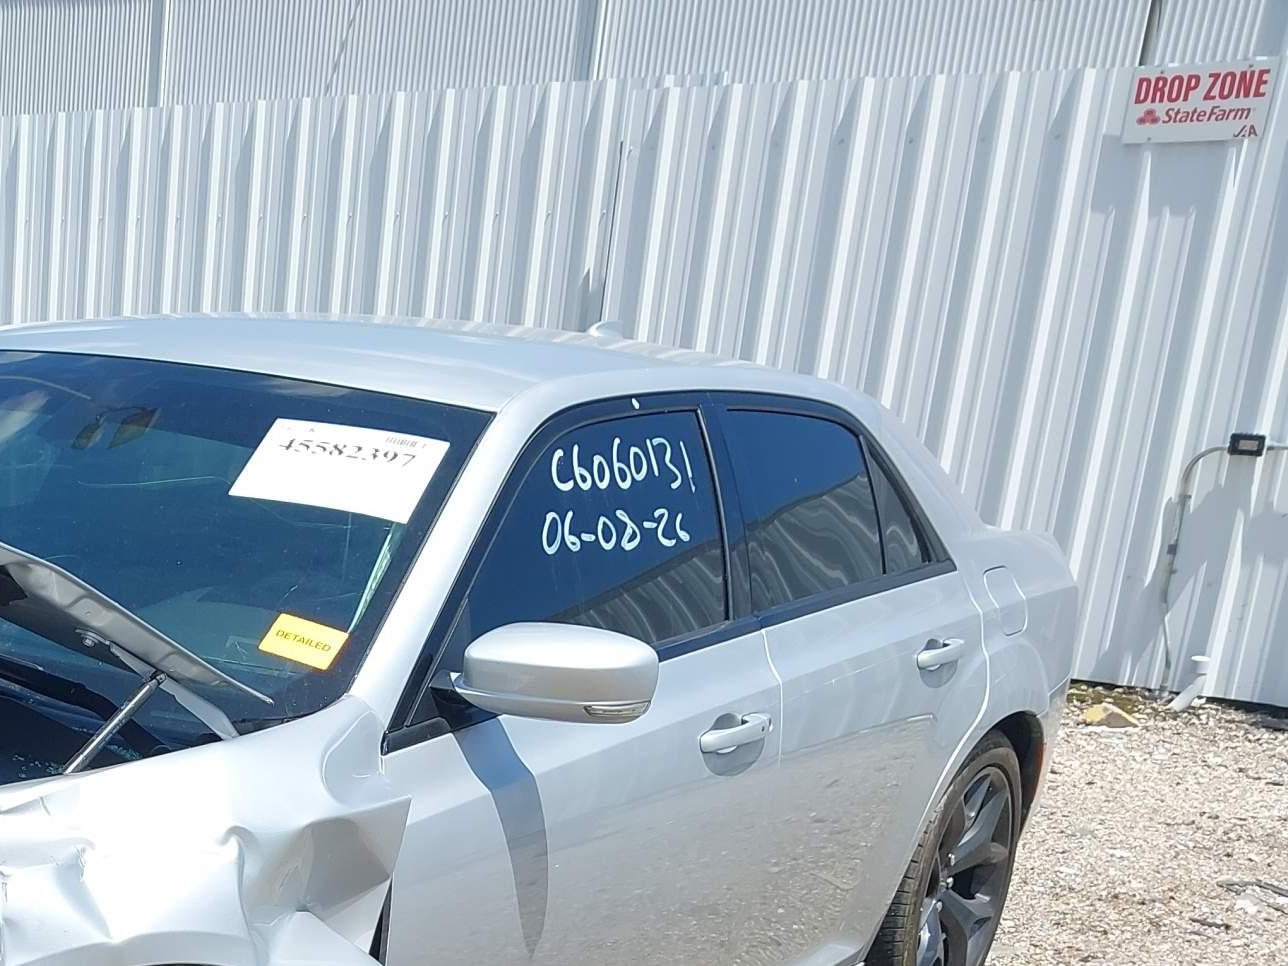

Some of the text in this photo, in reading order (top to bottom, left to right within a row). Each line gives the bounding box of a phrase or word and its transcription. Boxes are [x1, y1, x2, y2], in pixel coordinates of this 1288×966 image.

[1134, 69, 1271, 105] DROP ZONE
[1162, 106, 1251, 124] StateFarm
[279, 438, 416, 467] 45582397
[551, 437, 696, 494] C6060131
[542, 508, 691, 555] 06-08-26
[275, 629, 331, 652] DETAILED
